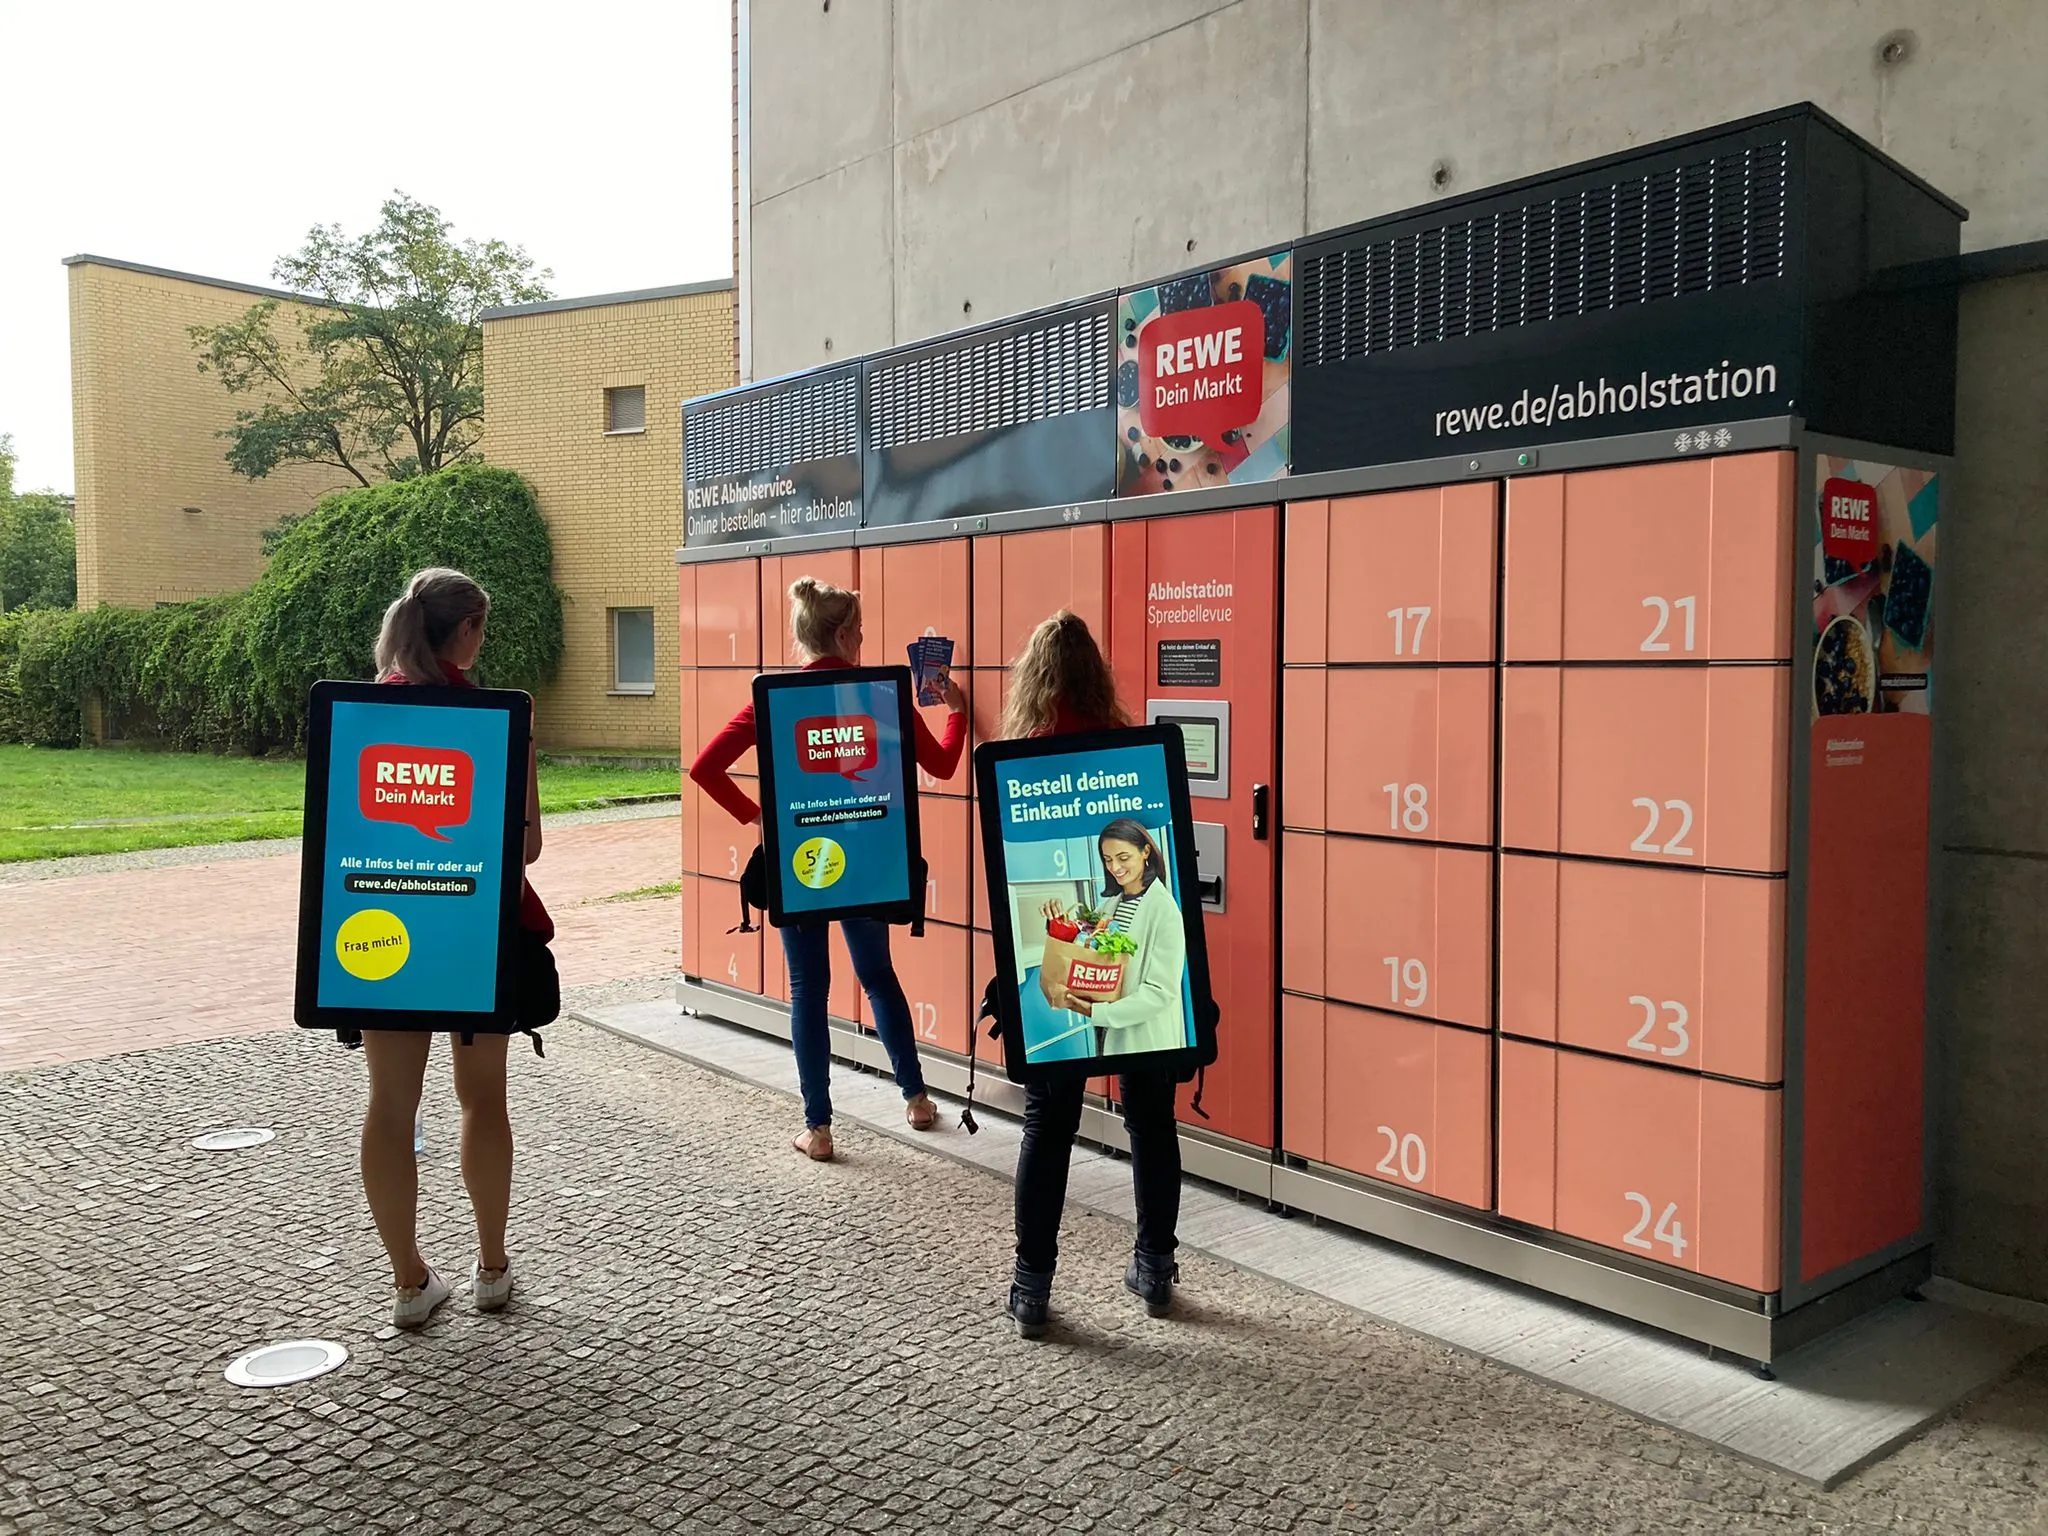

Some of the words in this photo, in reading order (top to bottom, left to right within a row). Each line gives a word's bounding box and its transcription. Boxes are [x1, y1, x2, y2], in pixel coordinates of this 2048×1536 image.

[1156, 327, 1243, 378] REWE
[1155, 383, 1188, 408] Dein
[1193, 373, 1243, 401] Markt
[1435, 360, 1776, 437] rewe.de/abholstation
[688, 485, 719, 510] REWE
[721, 475, 796, 505] Abholservice.
[688, 515, 718, 536] Online
[721, 509, 767, 532] bestellen
[780, 503, 803, 524] hier
[805, 496, 856, 522] abholen.
[1831, 496, 1870, 521] REWE
[1830, 523, 1846, 539] Dein
[1849, 525, 1870, 541] Markt
[1148, 579, 1233, 601] Abholstation
[1147, 604, 1232, 628] Spreebellevue
[1387, 606, 1431, 655] 17
[1640, 596, 1696, 652] 21
[729, 633, 736, 662] 1
[807, 725, 865, 746] REWE
[808, 748, 832, 760] Dein
[834, 744, 866, 759] Markt
[376, 761, 456, 786] REWE
[1007, 774, 1073, 799] Bestell
[1076, 770, 1139, 792] deinen
[375, 788, 407, 804] Dein
[410, 789, 455, 806] Markt
[789, 801, 806, 811] Alle
[807, 799, 828, 809] Infos
[829, 797, 842, 807] bei
[843, 796, 857, 806] mir
[858, 794, 876, 804] oder
[877, 792, 891, 802] auf
[1010, 797, 1081, 824] Einkauf
[1086, 794, 1143, 816] online
[1382, 782, 1429, 833] 18
[801, 808, 882, 825] rewe.de/abholstation
[1630, 797, 1694, 856] 22
[340, 857, 362, 868] Alle
[365, 857, 394, 870] Infos
[396, 859, 414, 870] bei
[416, 859, 435, 871] mir
[437, 860, 462, 872] oder
[465, 862, 484, 873] auf
[728, 846, 738, 876] 3
[1053, 850, 1067, 877] 9
[353, 878, 468, 892] rewe.de/abholstation
[344, 941, 369, 953] Frag
[371, 935, 402, 950] mich!
[727, 952, 738, 982] 4
[1073, 964, 1119, 981] REWE
[1071, 980, 1115, 990] Abholservice
[1383, 956, 1428, 1008] 19
[914, 1002, 937, 1040] 12
[1627, 995, 1689, 1057] 23
[1376, 1125, 1427, 1183] 20
[1623, 1191, 1688, 1258] 24
